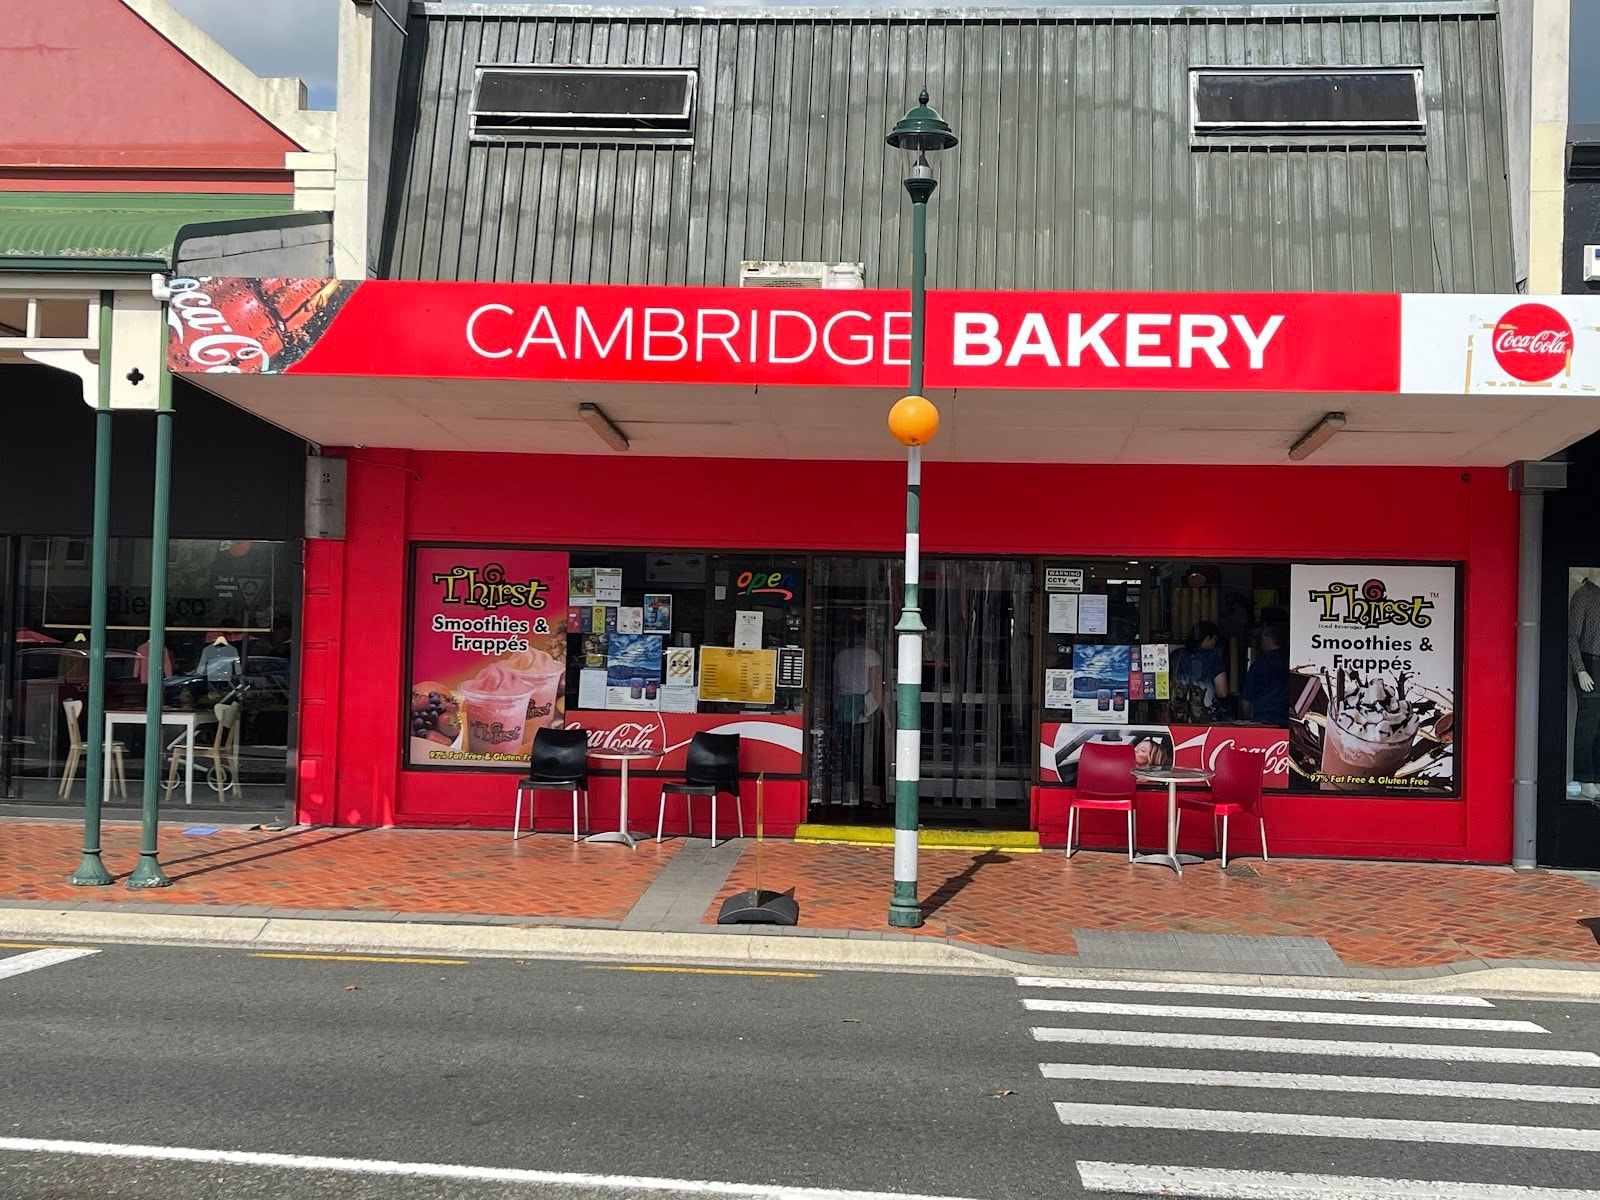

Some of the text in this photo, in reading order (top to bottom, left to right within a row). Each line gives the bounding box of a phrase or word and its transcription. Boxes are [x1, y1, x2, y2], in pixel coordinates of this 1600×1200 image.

[466, 303, 1285, 369] CAMBRIDGE BAKERY
[1495, 330, 1570, 354] Coca-Cola
[432, 563, 549, 610] Thirst
[736, 570, 794, 595] open
[1309, 579, 1435, 629] Thirst
[433, 615, 549, 633] Smoothies &
[454, 635, 529, 654] Frappés
[1311, 634, 1434, 652] Smoothies &
[1333, 654, 1412, 673] Frappés
[429, 751, 532, 762] 97% Fat Free & Gluten Fr
[1310, 774, 1430, 786] 97% Fat Free & Gluten Free
